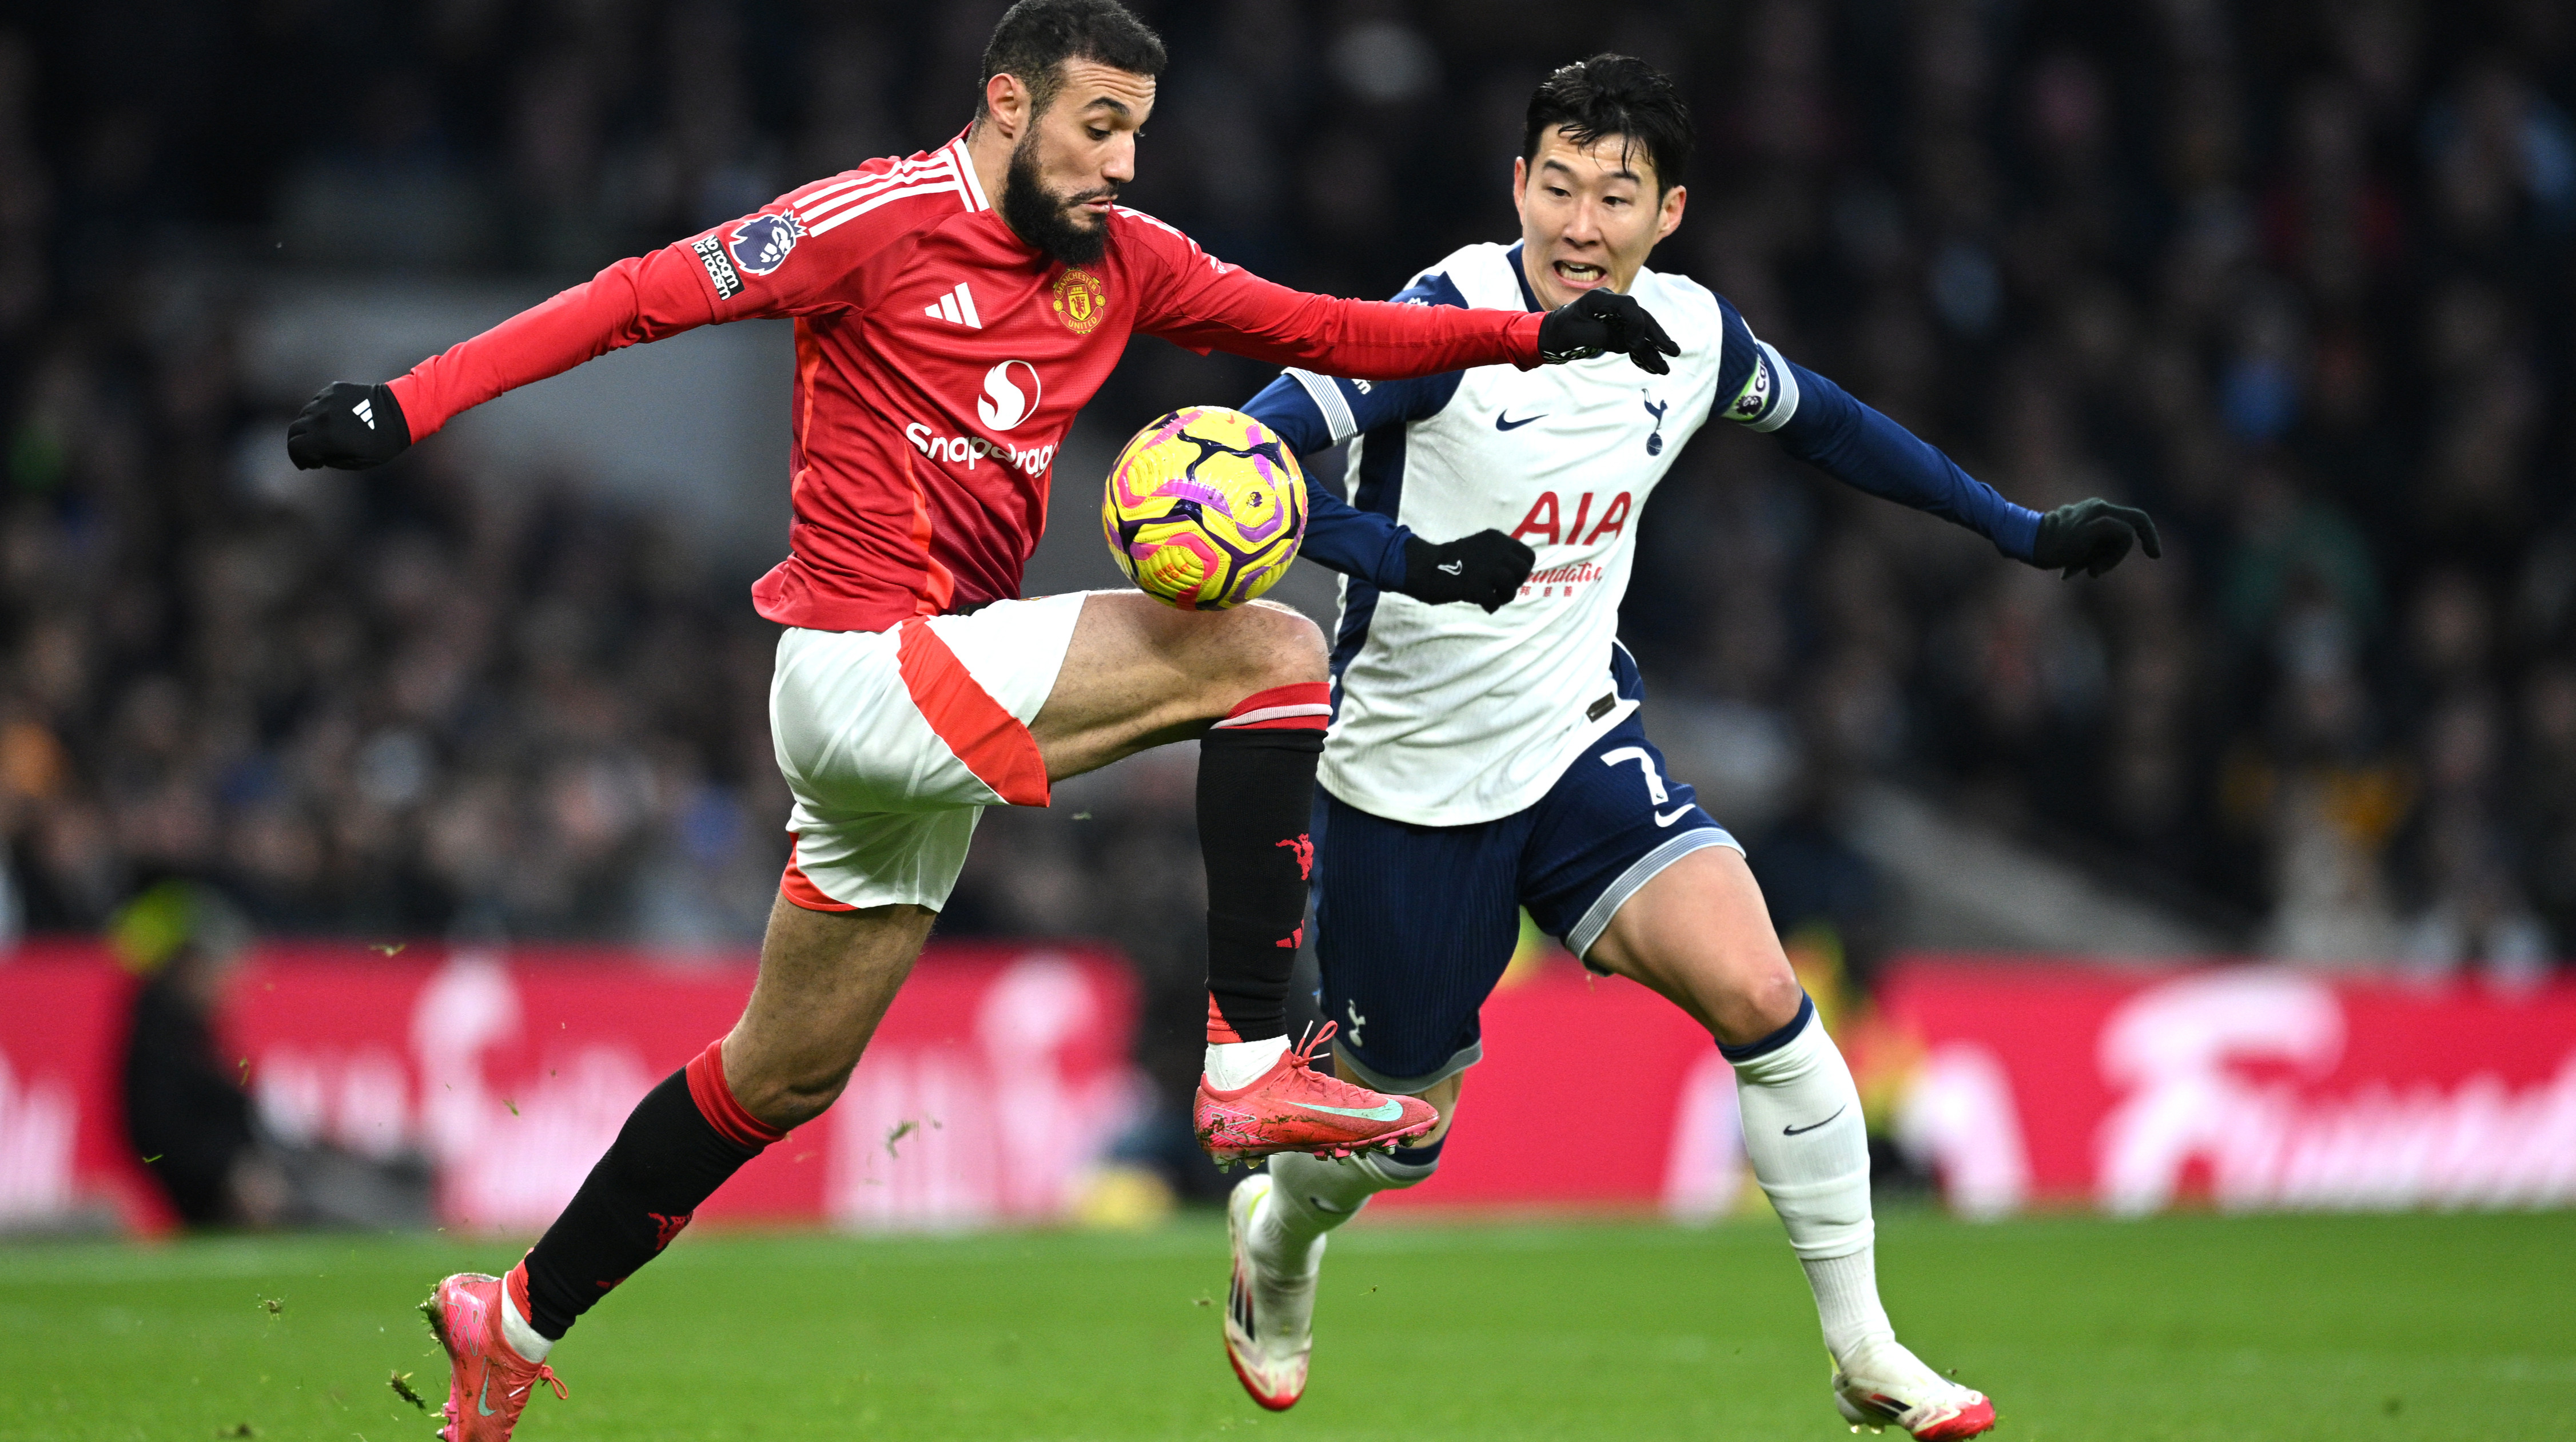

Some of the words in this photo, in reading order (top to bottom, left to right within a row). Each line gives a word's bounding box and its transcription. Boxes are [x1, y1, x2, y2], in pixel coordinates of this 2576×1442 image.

[700, 253, 731, 300] racism
[704, 234, 719, 251] No
[712, 249, 739, 289] room
[1056, 272, 1097, 295] MANCHESTER
[1068, 316, 1097, 330] UNITED
[906, 422, 1058, 478] Snapdrag
[1510, 491, 1632, 546] AIA
[1153, 563, 1176, 578] NIKE
[1599, 746, 1669, 806] 7
